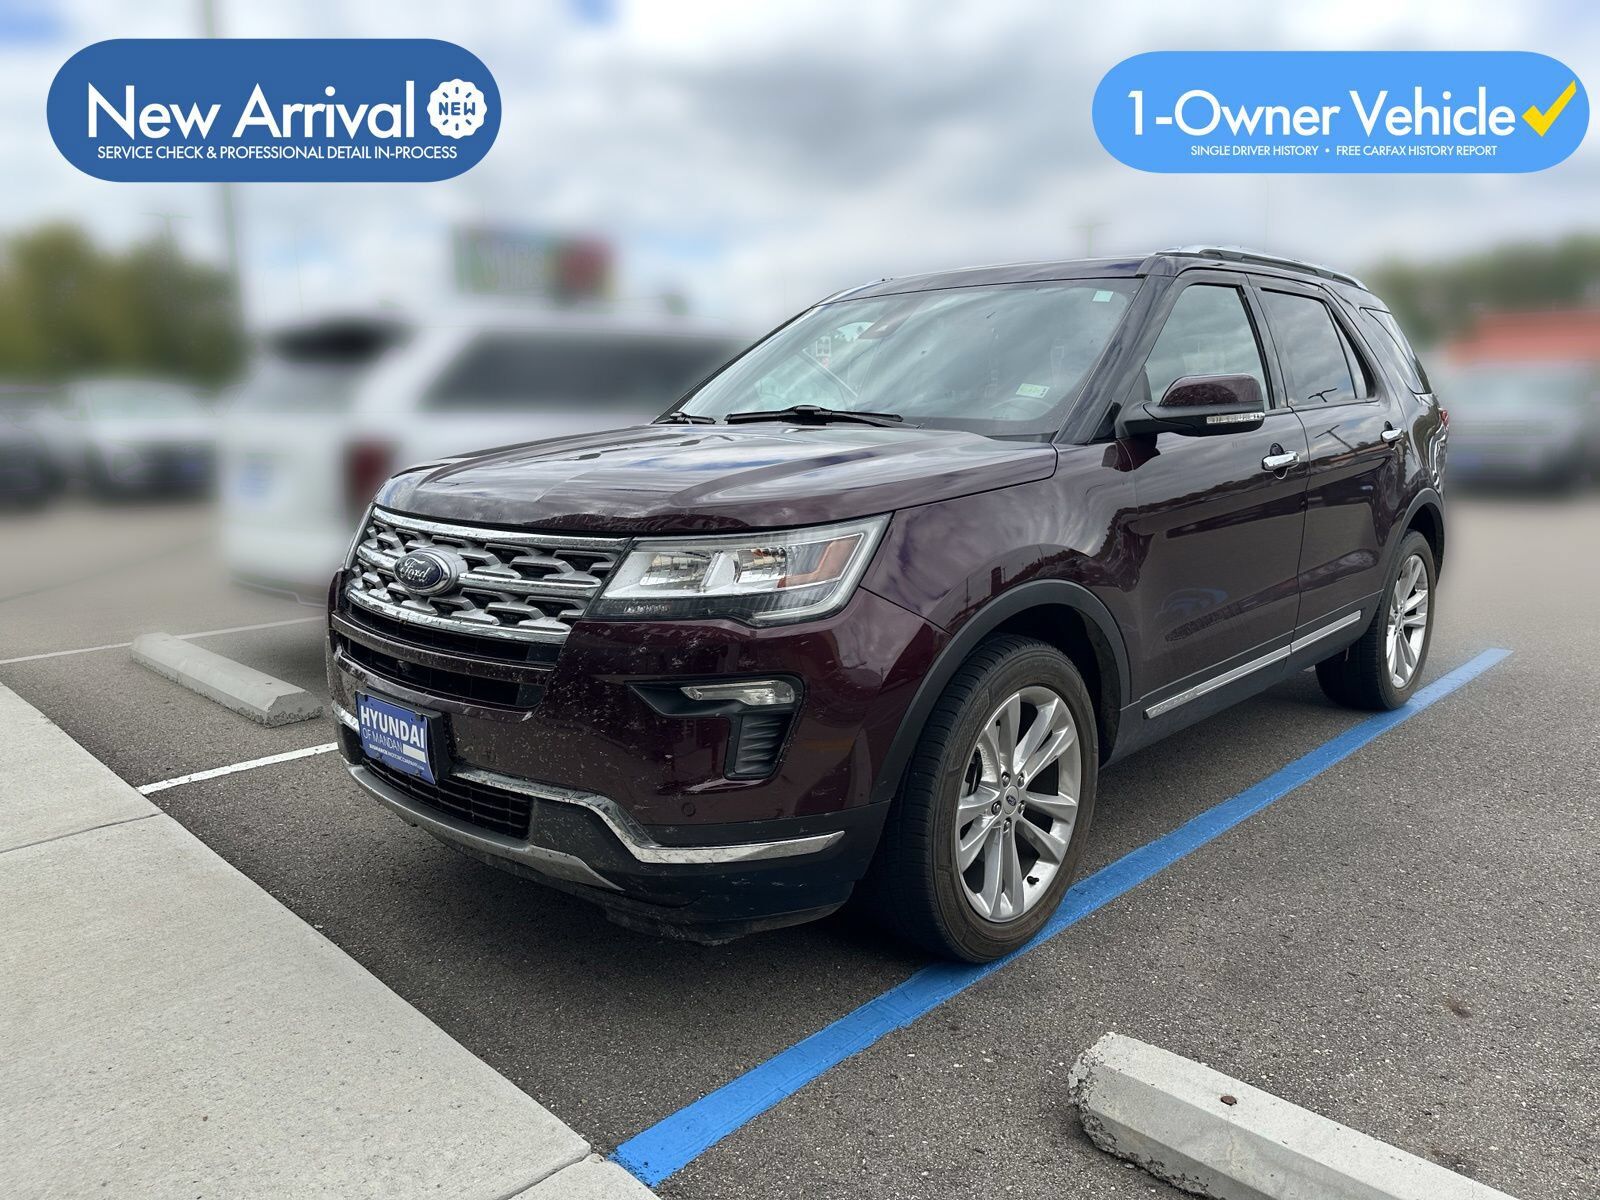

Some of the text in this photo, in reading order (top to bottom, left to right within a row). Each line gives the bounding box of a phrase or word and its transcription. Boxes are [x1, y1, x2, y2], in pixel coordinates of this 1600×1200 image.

[399, 557, 431, 583] Ford
[360, 705, 425, 749] HYUNDAI
[362, 727, 371, 740] OF
